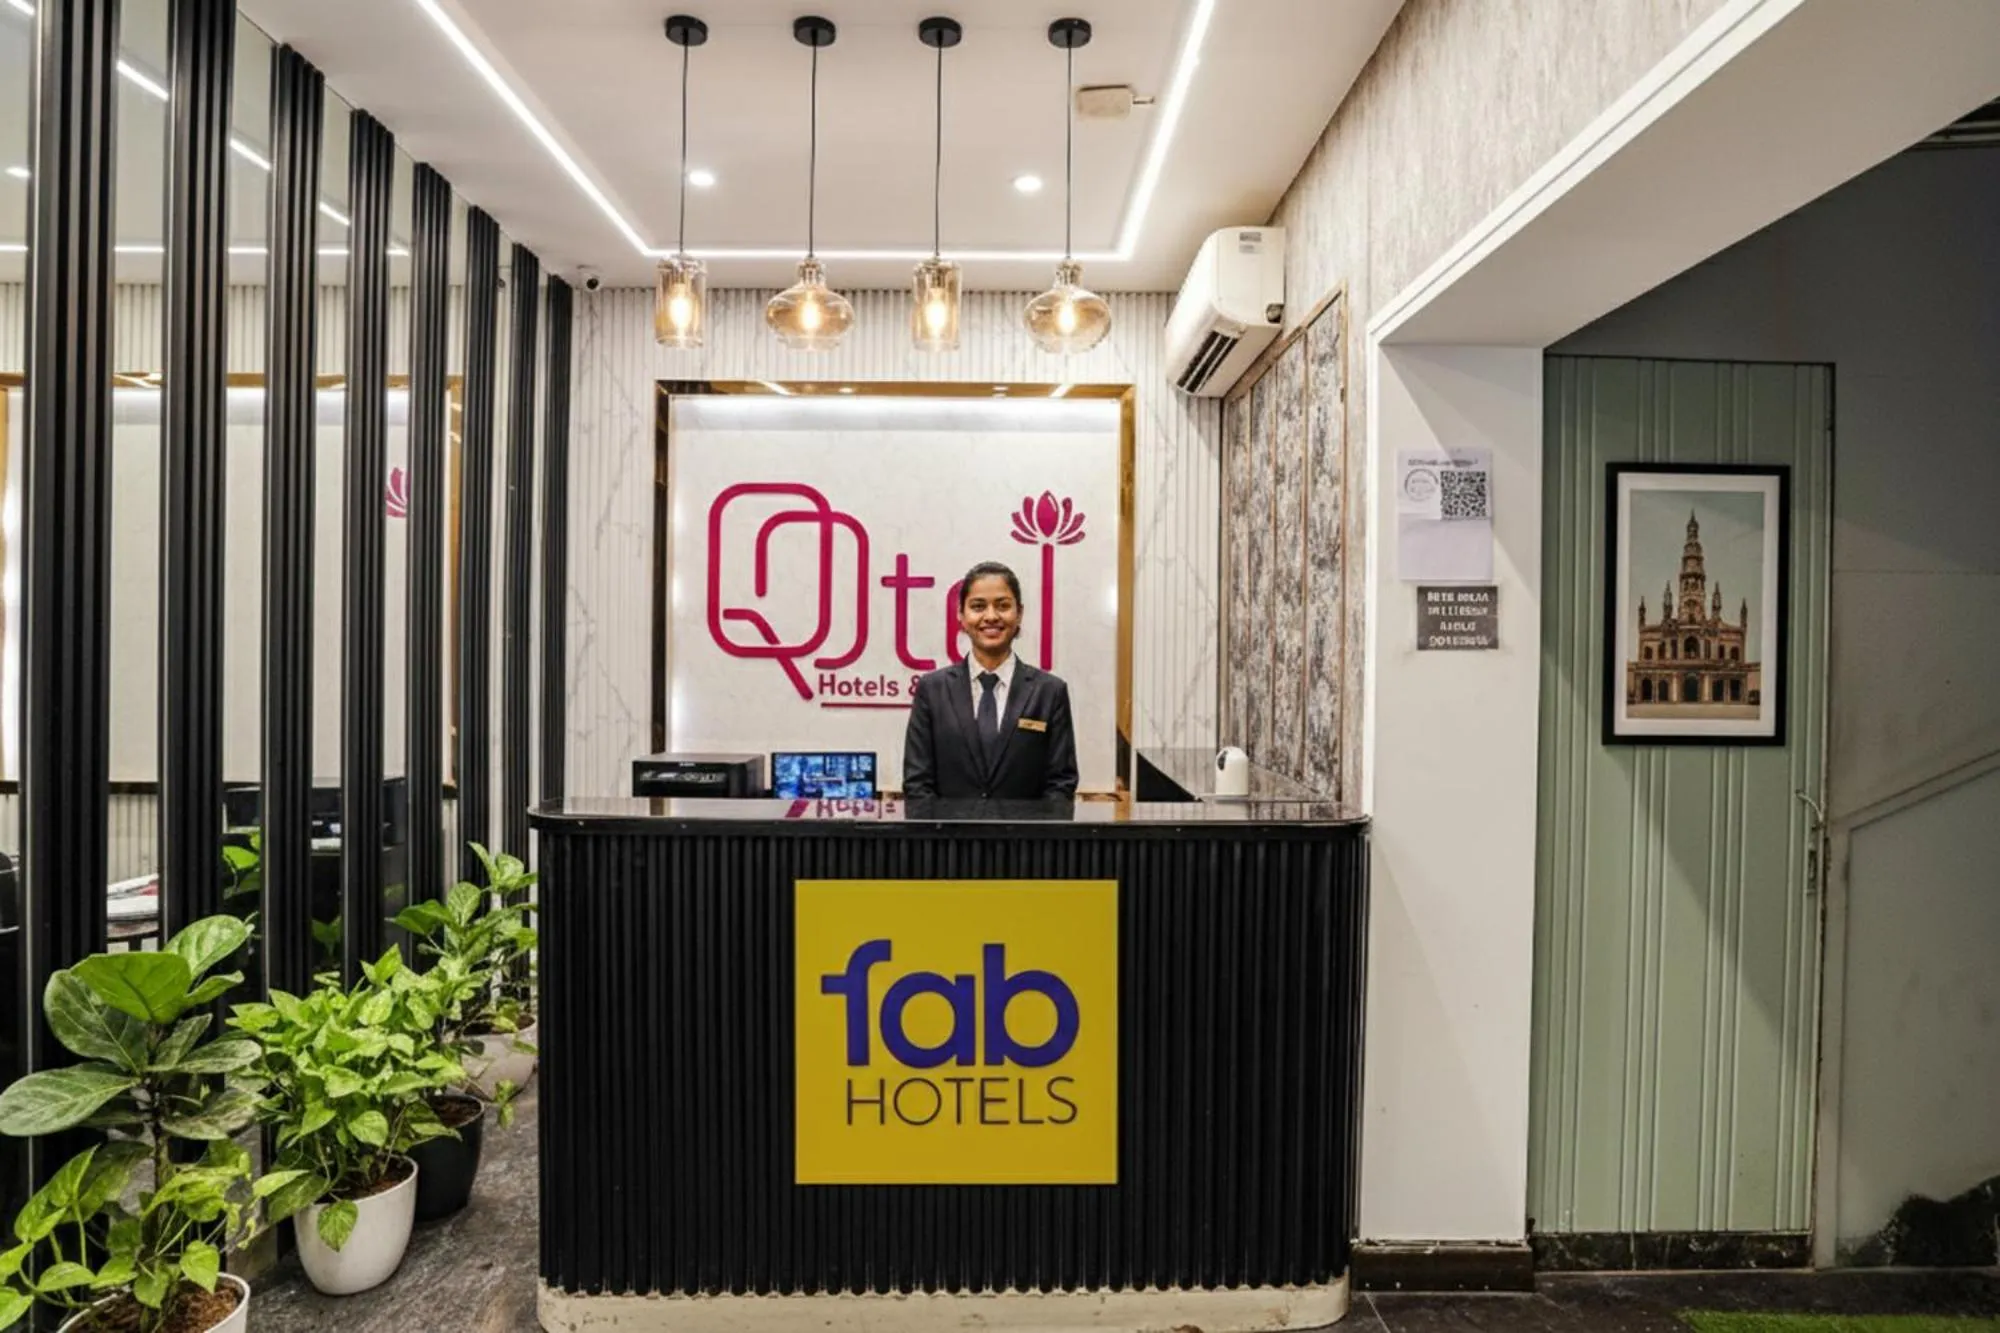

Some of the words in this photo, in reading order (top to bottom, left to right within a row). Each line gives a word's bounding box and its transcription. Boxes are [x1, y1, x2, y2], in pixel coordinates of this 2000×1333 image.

[818, 673, 899, 697] Hotels
[821, 938, 1080, 1070] fab
[846, 1076, 1078, 1126] HOTELS
